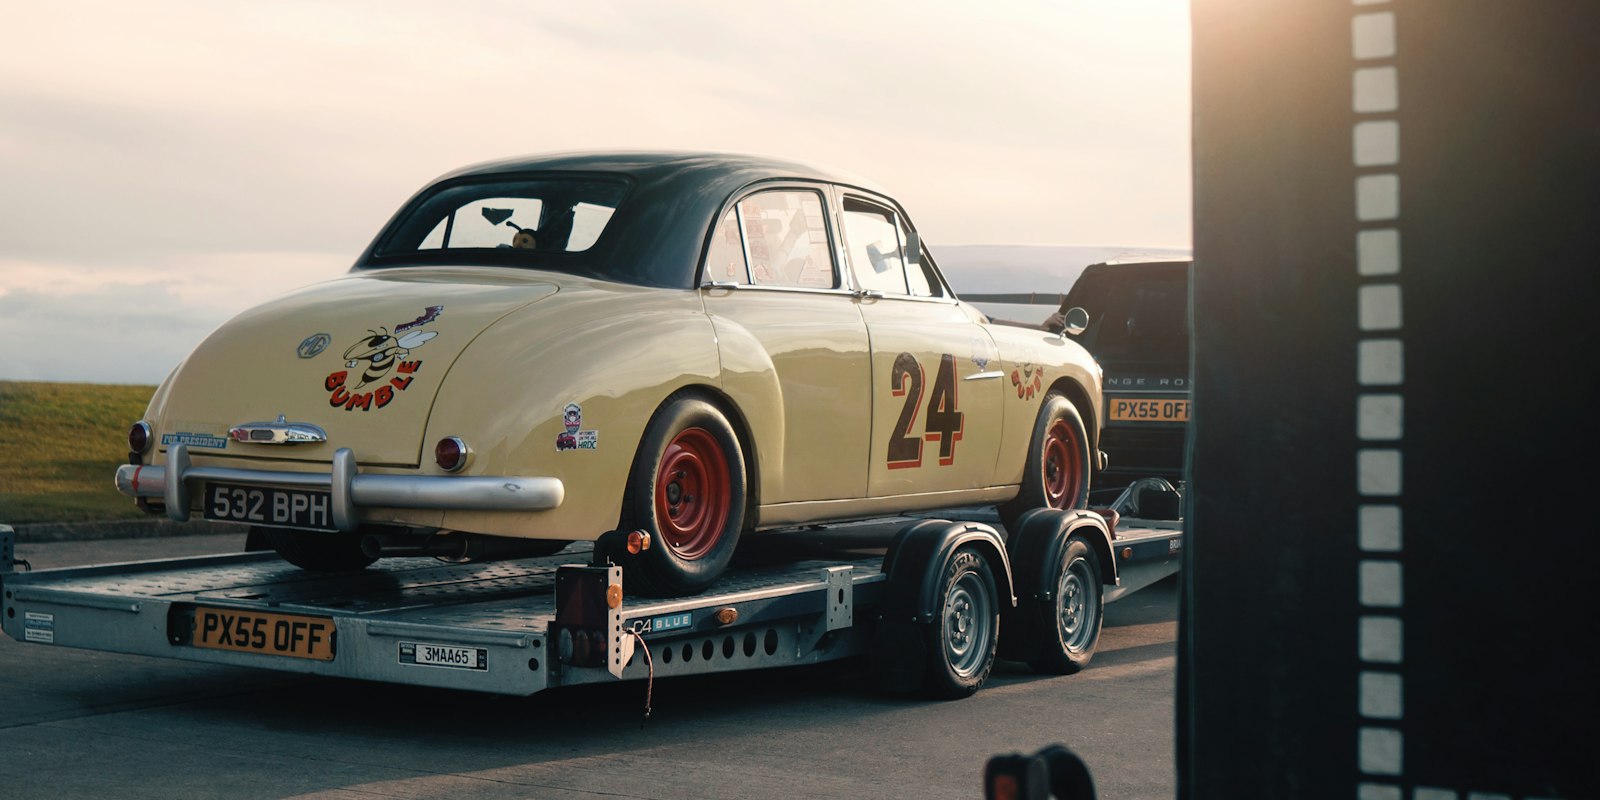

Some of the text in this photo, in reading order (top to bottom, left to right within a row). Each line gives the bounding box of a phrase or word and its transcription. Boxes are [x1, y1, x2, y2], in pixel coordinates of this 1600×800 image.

[299, 335, 330, 357] MG
[324, 360, 423, 412] BUMBLE
[1010, 366, 1044, 401] BUMBL
[886, 351, 964, 470] 24
[1117, 401, 1159, 418] PX55
[163, 435, 226, 448] FOR PRESIDENT
[213, 487, 328, 526] 532 BPH
[202, 613, 325, 654] PX55 OFF
[633, 615, 689, 635] C4 BLUE
[424, 646, 469, 665] 3MAA65
